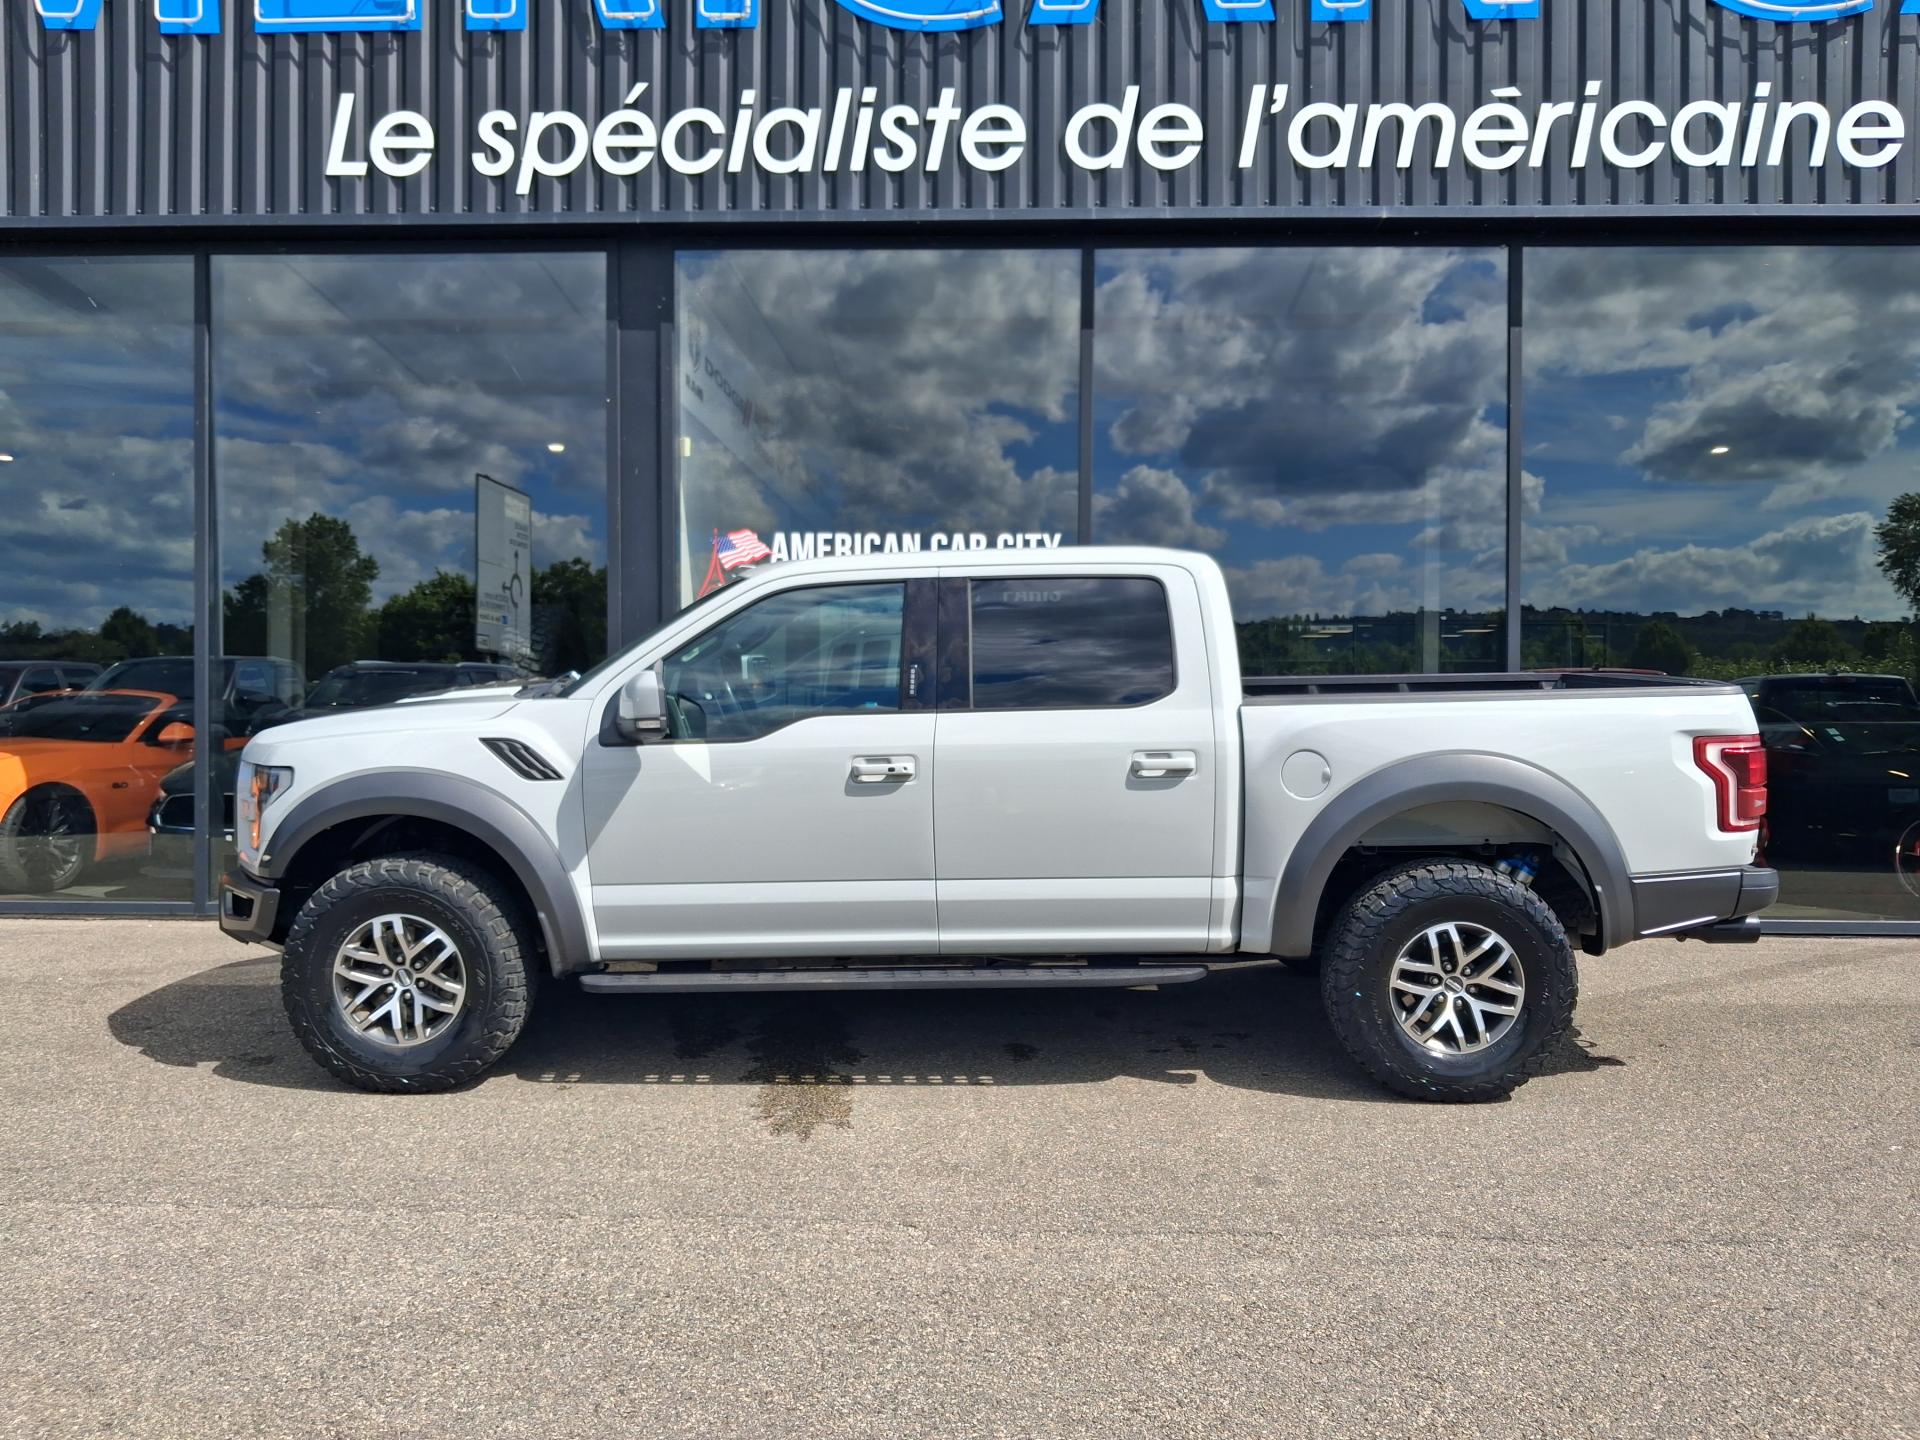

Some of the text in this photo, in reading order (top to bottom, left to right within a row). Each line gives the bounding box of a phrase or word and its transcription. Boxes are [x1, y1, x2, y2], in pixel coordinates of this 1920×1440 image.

[325, 93, 435, 177] Le
[472, 82, 1027, 195] spécialiste
[1065, 85, 1203, 170] de
[770, 532, 920, 563] AMERICAN
